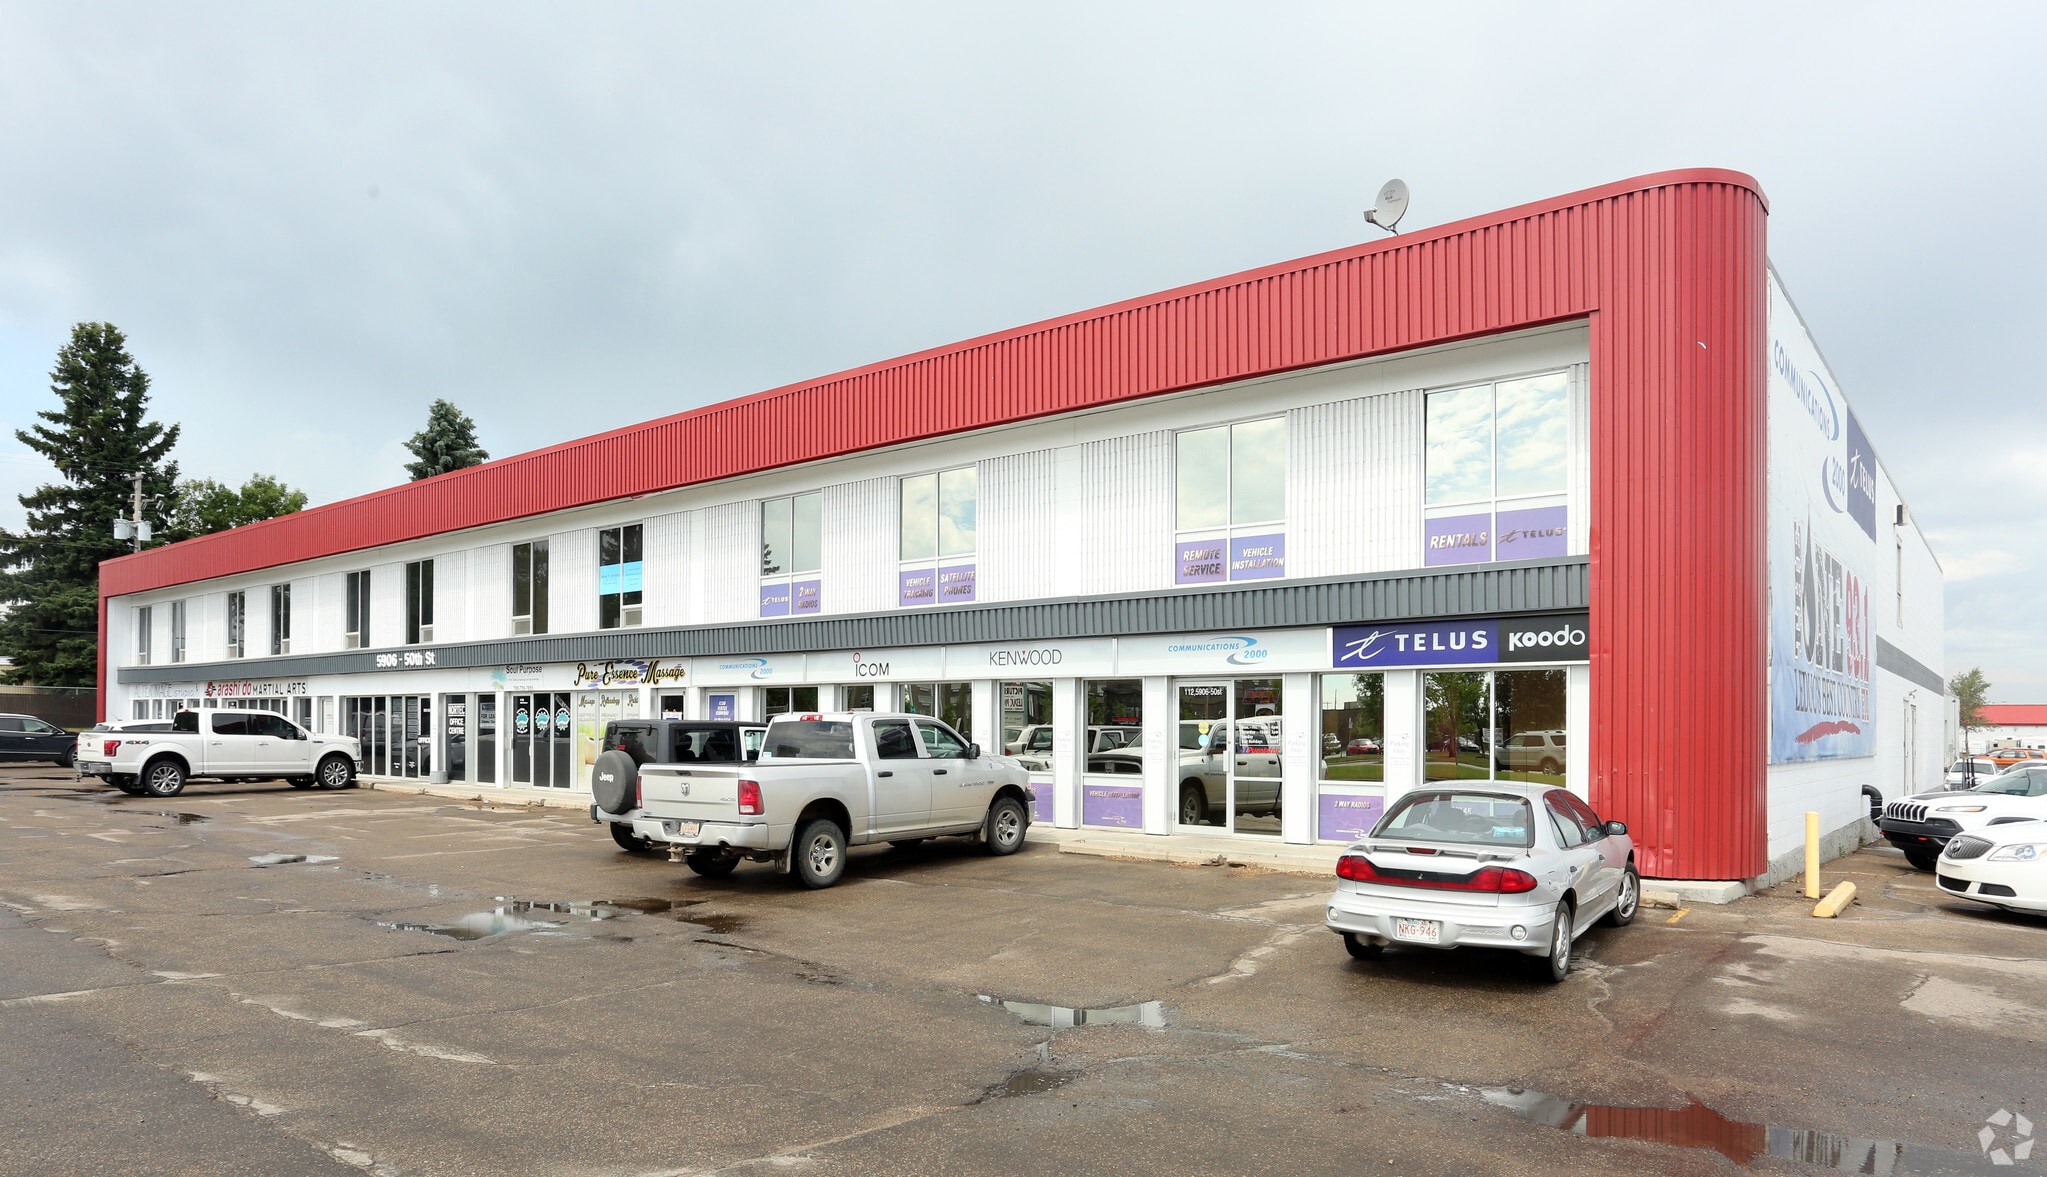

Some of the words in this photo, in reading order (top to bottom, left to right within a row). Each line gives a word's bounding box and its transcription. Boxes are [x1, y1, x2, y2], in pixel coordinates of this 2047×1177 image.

[1774, 339, 1830, 441] COMMUNICATIONS
[1832, 455, 1845, 497] 2000
[1859, 461, 1875, 505] TELUS
[1522, 527, 1562, 539] TELUS
[1430, 531, 1488, 550] RENTALS
[1183, 548, 1221, 561] REMOTE
[1242, 546, 1274, 558] VEHICLE
[1183, 562, 1221, 576] SERVICE
[1231, 557, 1284, 571] INSTALLATION
[906, 576, 931, 588] VEHICLE
[940, 571, 976, 583] SATELLITE
[799, 586, 804, 597] 2
[804, 587, 816, 597] WAY
[904, 589, 933, 599] TRACKING
[944, 585, 971, 596] PHONES
[1395, 630, 1488, 652] TELUS
[1168, 643, 1240, 653] COMMUNICATIONS
[1244, 650, 1267, 659] 2000
[377, 654, 397, 668] 5906
[404, 652, 423, 666] 50th
[425, 651, 435, 665] St
[989, 649, 1062, 666] KENWOOD
[505, 665, 518, 674] Soul
[520, 665, 542, 675] Purpose
[574, 663, 598, 686] Pure
[602, 661, 638, 685] Essence
[641, 660, 685, 685] Massage
[217, 680, 241, 697] arashi
[242, 680, 251, 695] do
[252, 683, 283, 695] MARTIAL
[287, 682, 306, 694] ARTS
[1245, 690, 1278, 703] OPEN
[449, 717, 464, 726] OFFICE
[599, 771, 614, 783] Jeep
[1399, 923, 1437, 937] NKG-946
